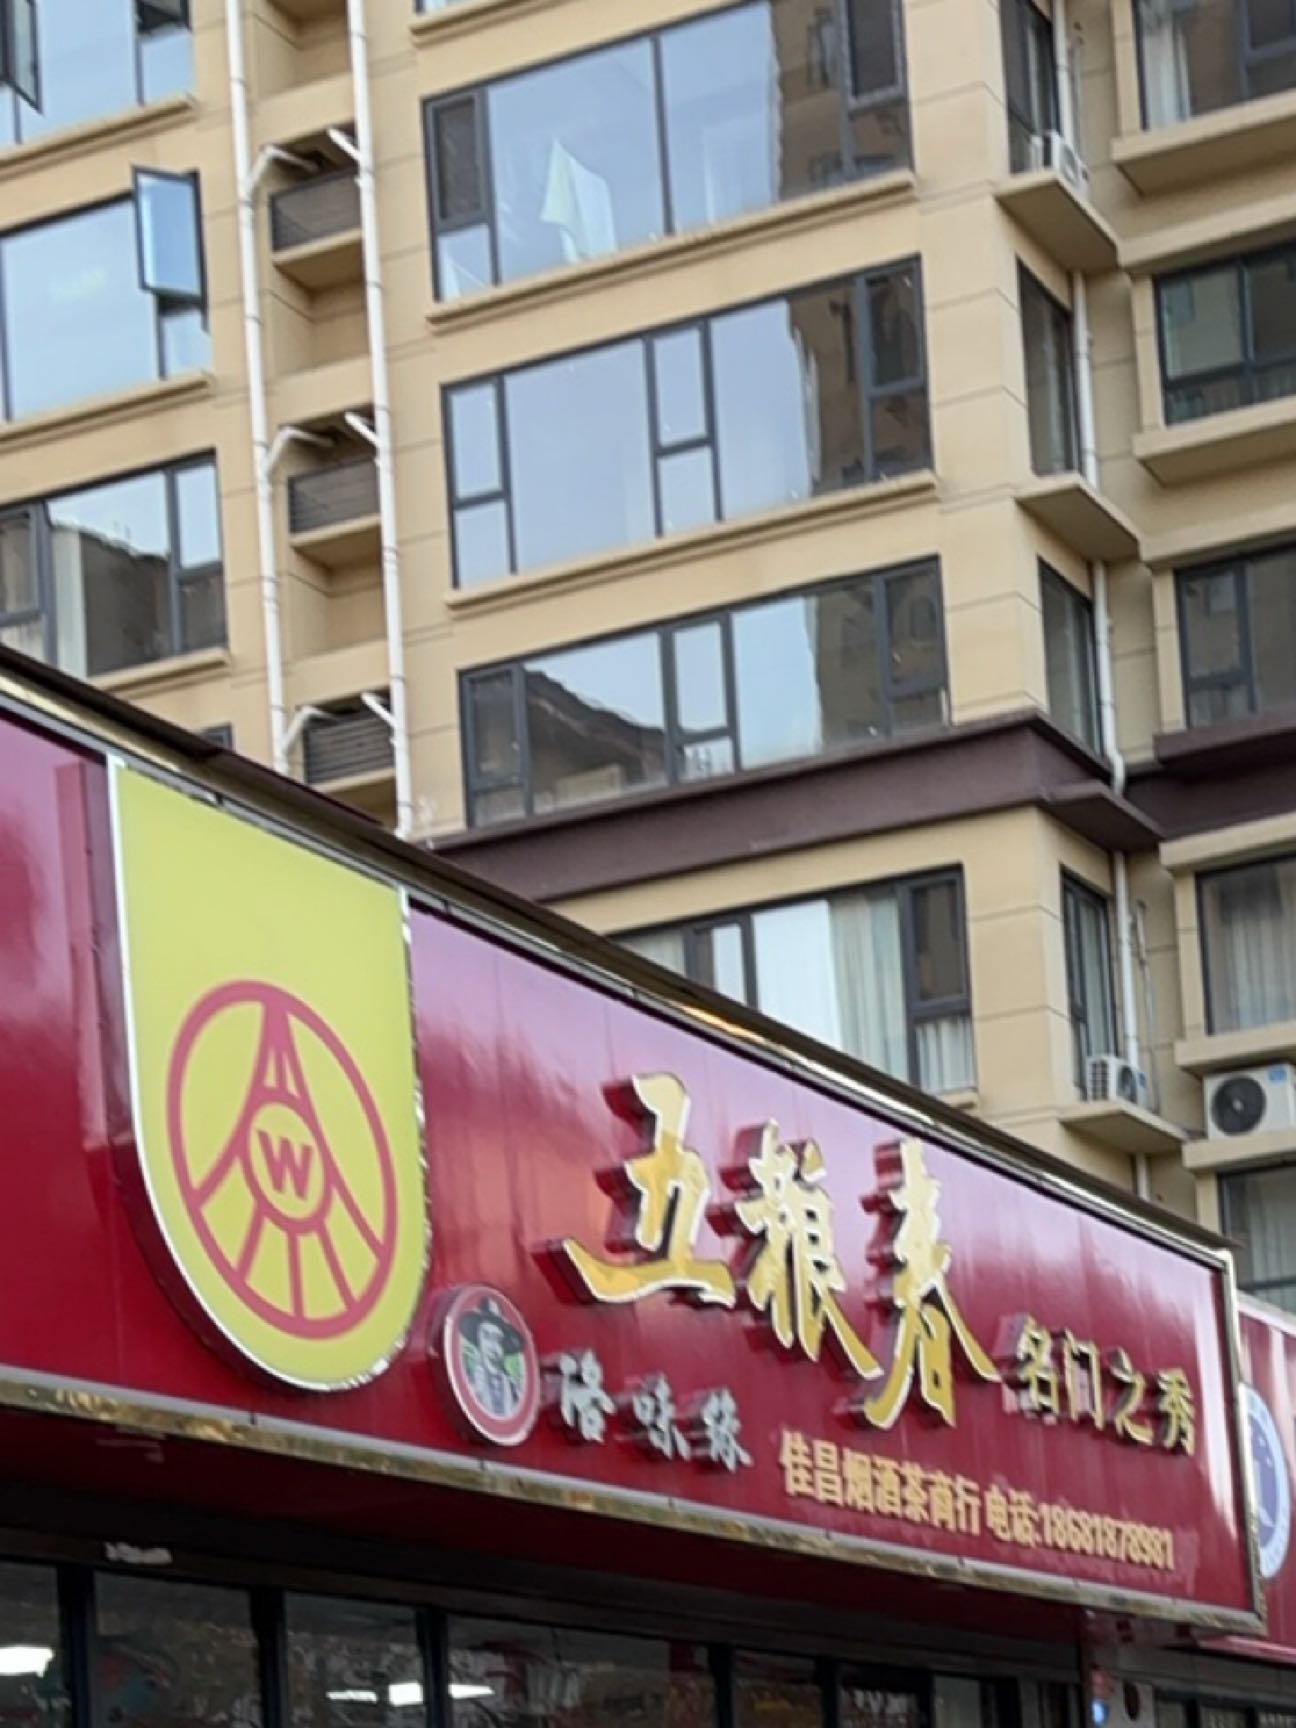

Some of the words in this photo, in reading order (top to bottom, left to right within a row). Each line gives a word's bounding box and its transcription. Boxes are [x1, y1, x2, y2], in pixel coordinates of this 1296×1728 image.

[257, 1128, 314, 1197] W
[563, 1072, 1001, 1429] 五粮春
[1017, 1314, 1196, 1457] 名门之秀
[779, 1427, 981, 1537] 佳昌烟酒茶商行
